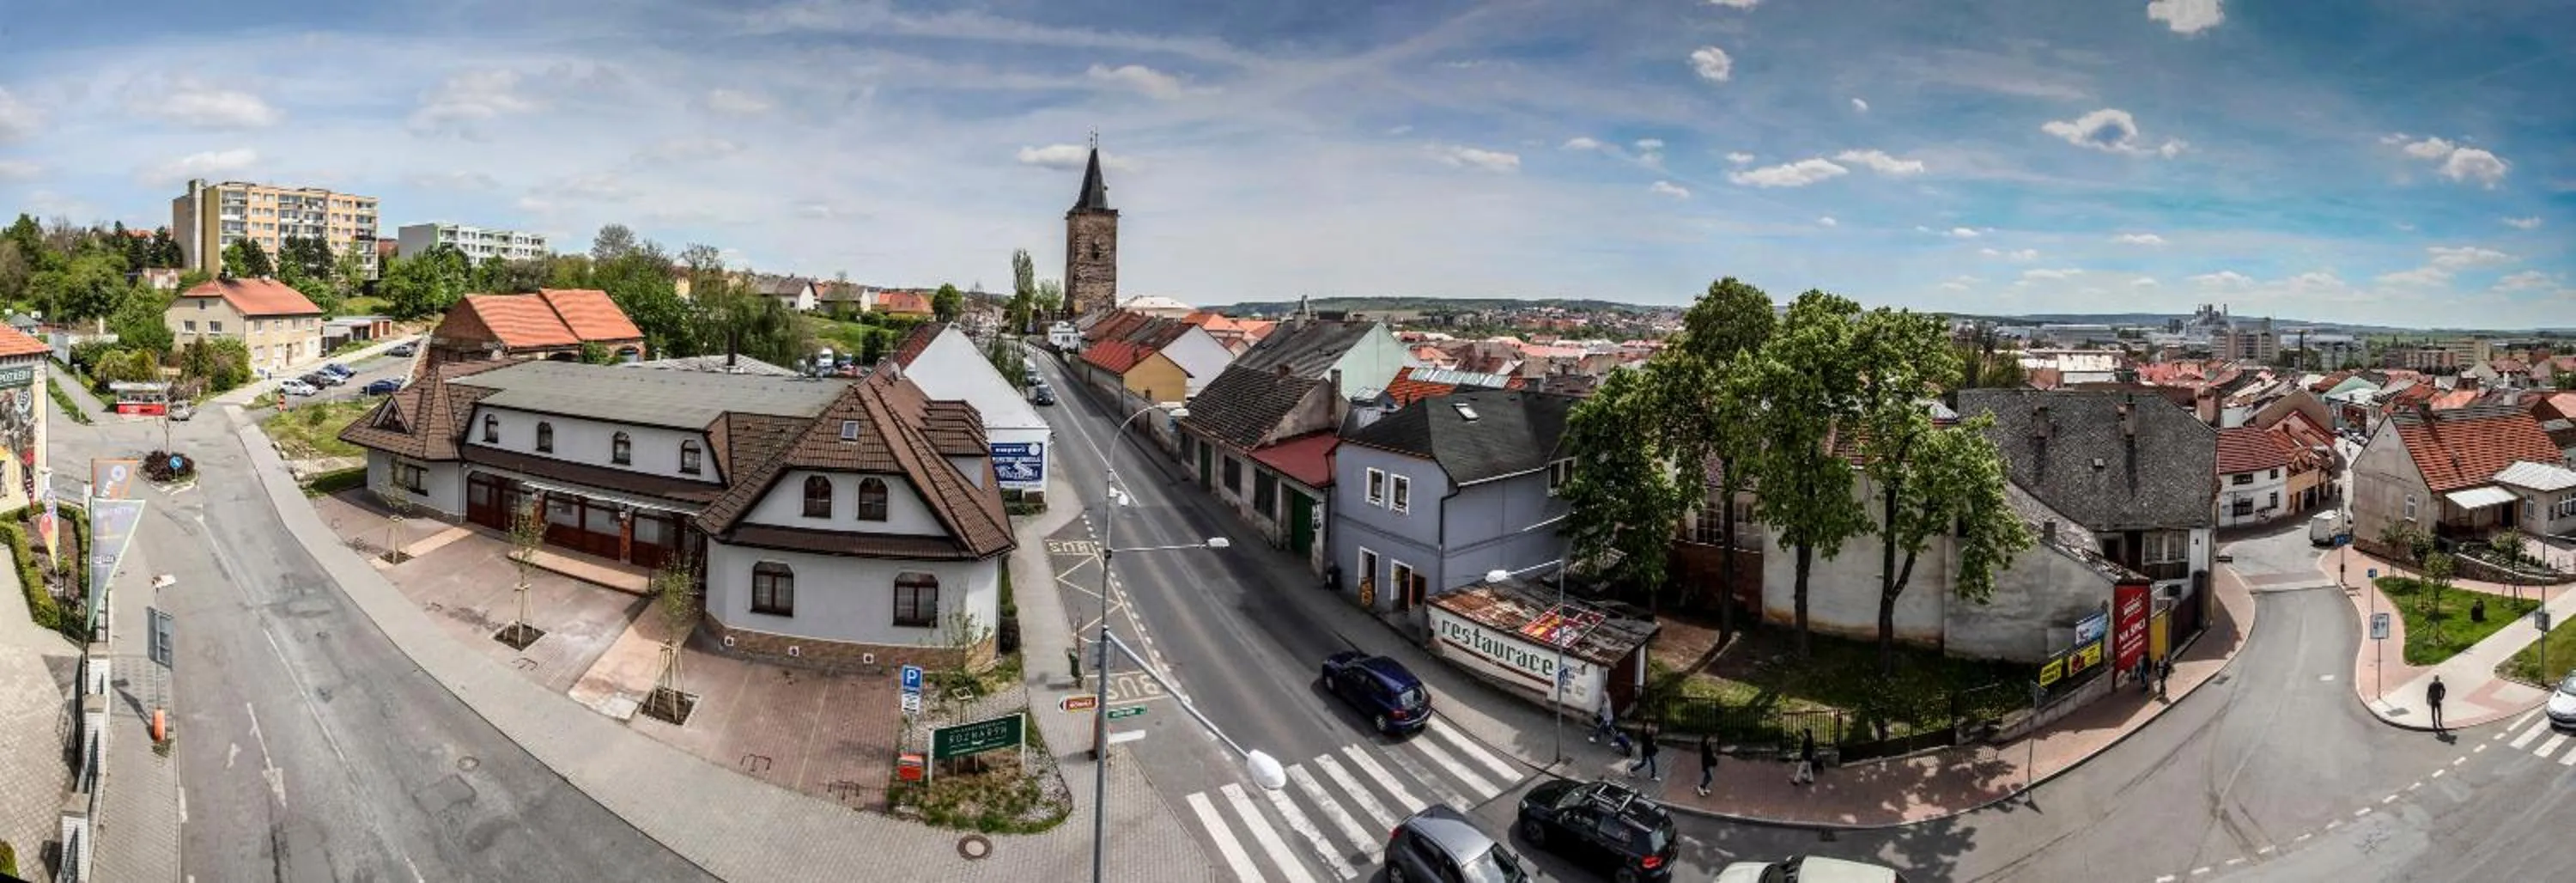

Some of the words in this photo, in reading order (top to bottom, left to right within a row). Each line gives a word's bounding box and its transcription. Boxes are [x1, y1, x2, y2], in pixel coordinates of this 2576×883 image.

[1442, 619, 1553, 676] restaurace
[906, 669, 918, 685] P
[1102, 674, 1160, 700] BUS
